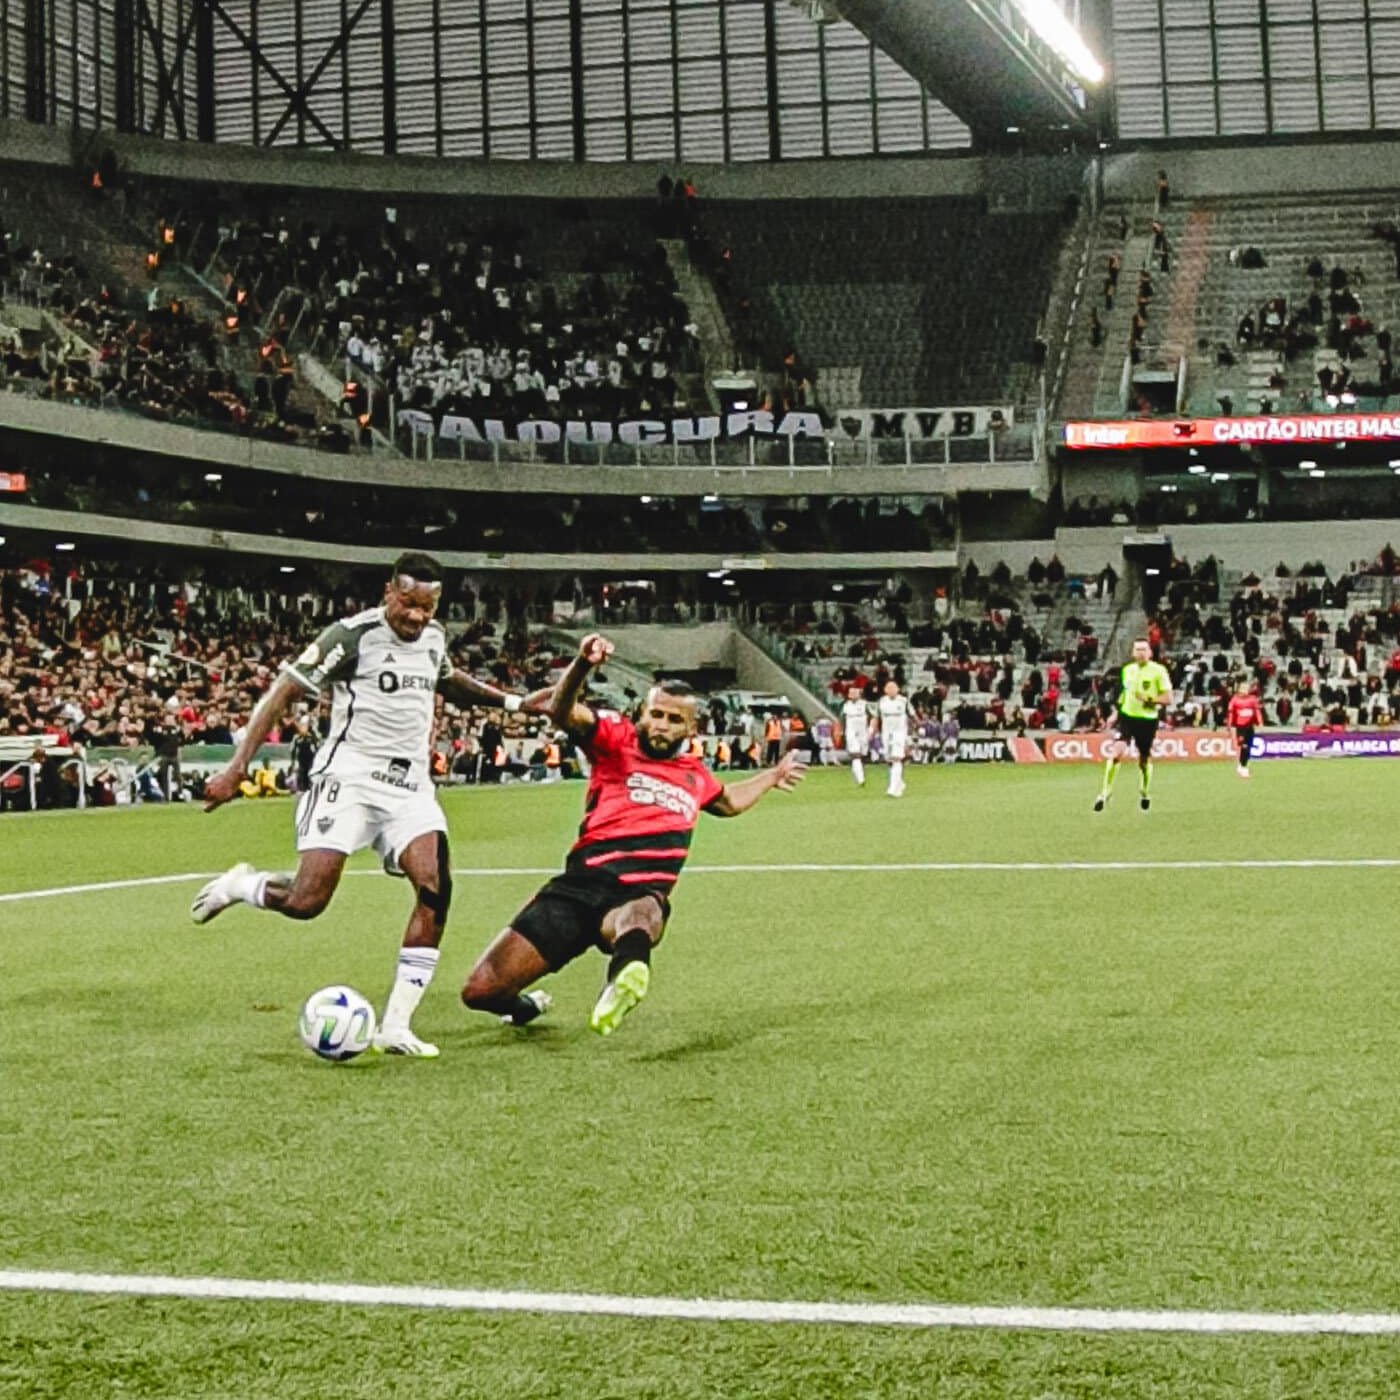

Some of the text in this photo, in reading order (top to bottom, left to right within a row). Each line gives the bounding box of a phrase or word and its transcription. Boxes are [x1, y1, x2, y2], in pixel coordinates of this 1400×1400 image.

[872, 411, 976, 439] MVB
[1083, 425, 1129, 445] inter
[1213, 414, 1299, 441] CARTÃO
[1300, 416, 1359, 438] INTER
[1052, 738, 1093, 759] GOL
[1151, 737, 1193, 758] GOL
[1195, 736, 1237, 757] GOL
[326, 780, 341, 803] 8
